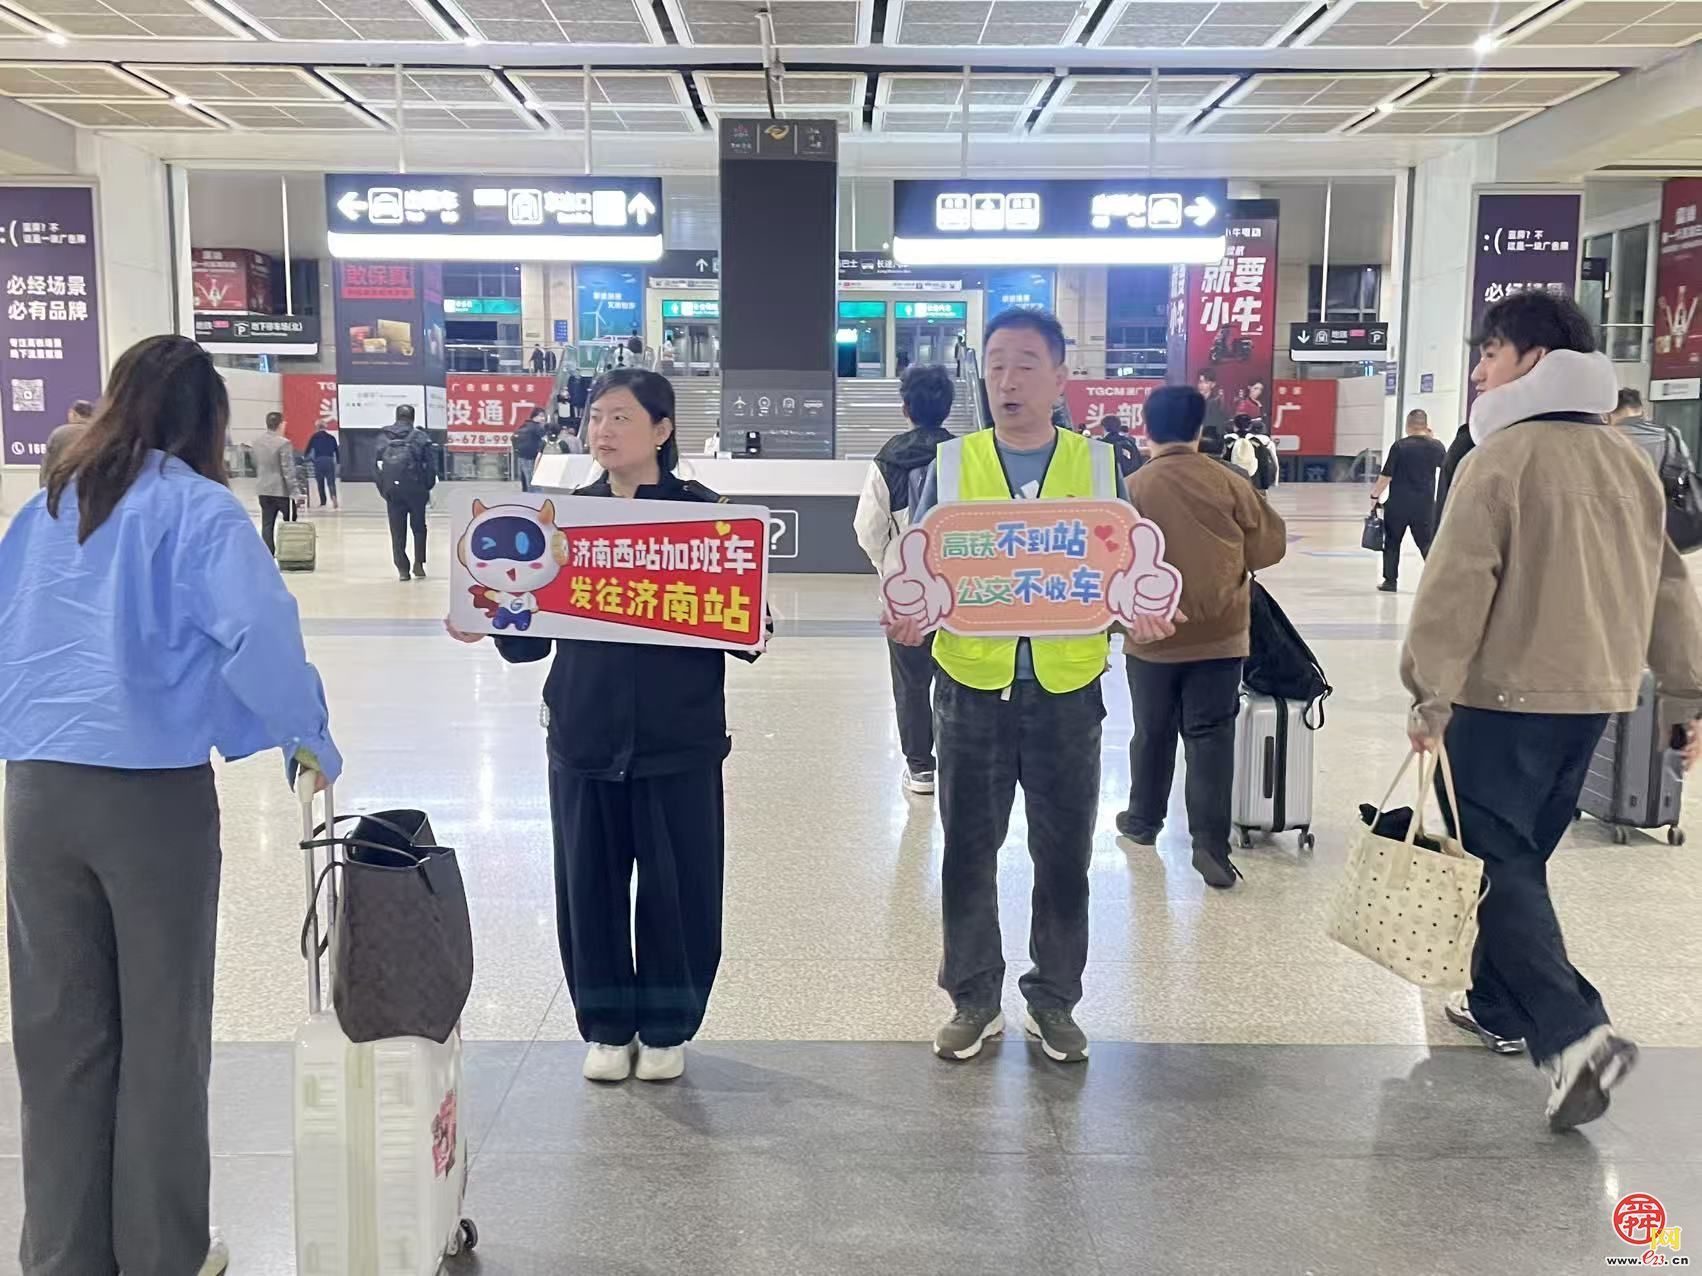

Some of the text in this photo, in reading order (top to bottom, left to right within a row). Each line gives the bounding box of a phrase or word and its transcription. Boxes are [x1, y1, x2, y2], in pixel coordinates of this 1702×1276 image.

[839, 259, 858, 269] 巴士
[1201, 257, 1266, 293] 就要
[6, 275, 88, 296] 必经场景
[8, 300, 89, 321] 必有品牌
[572, 534, 757, 575] 济南西站加班车
[942, 519, 1088, 560] 高铁不到站
[569, 576, 752, 633] 发往济南站
[956, 565, 1104, 607] 公交不收车
